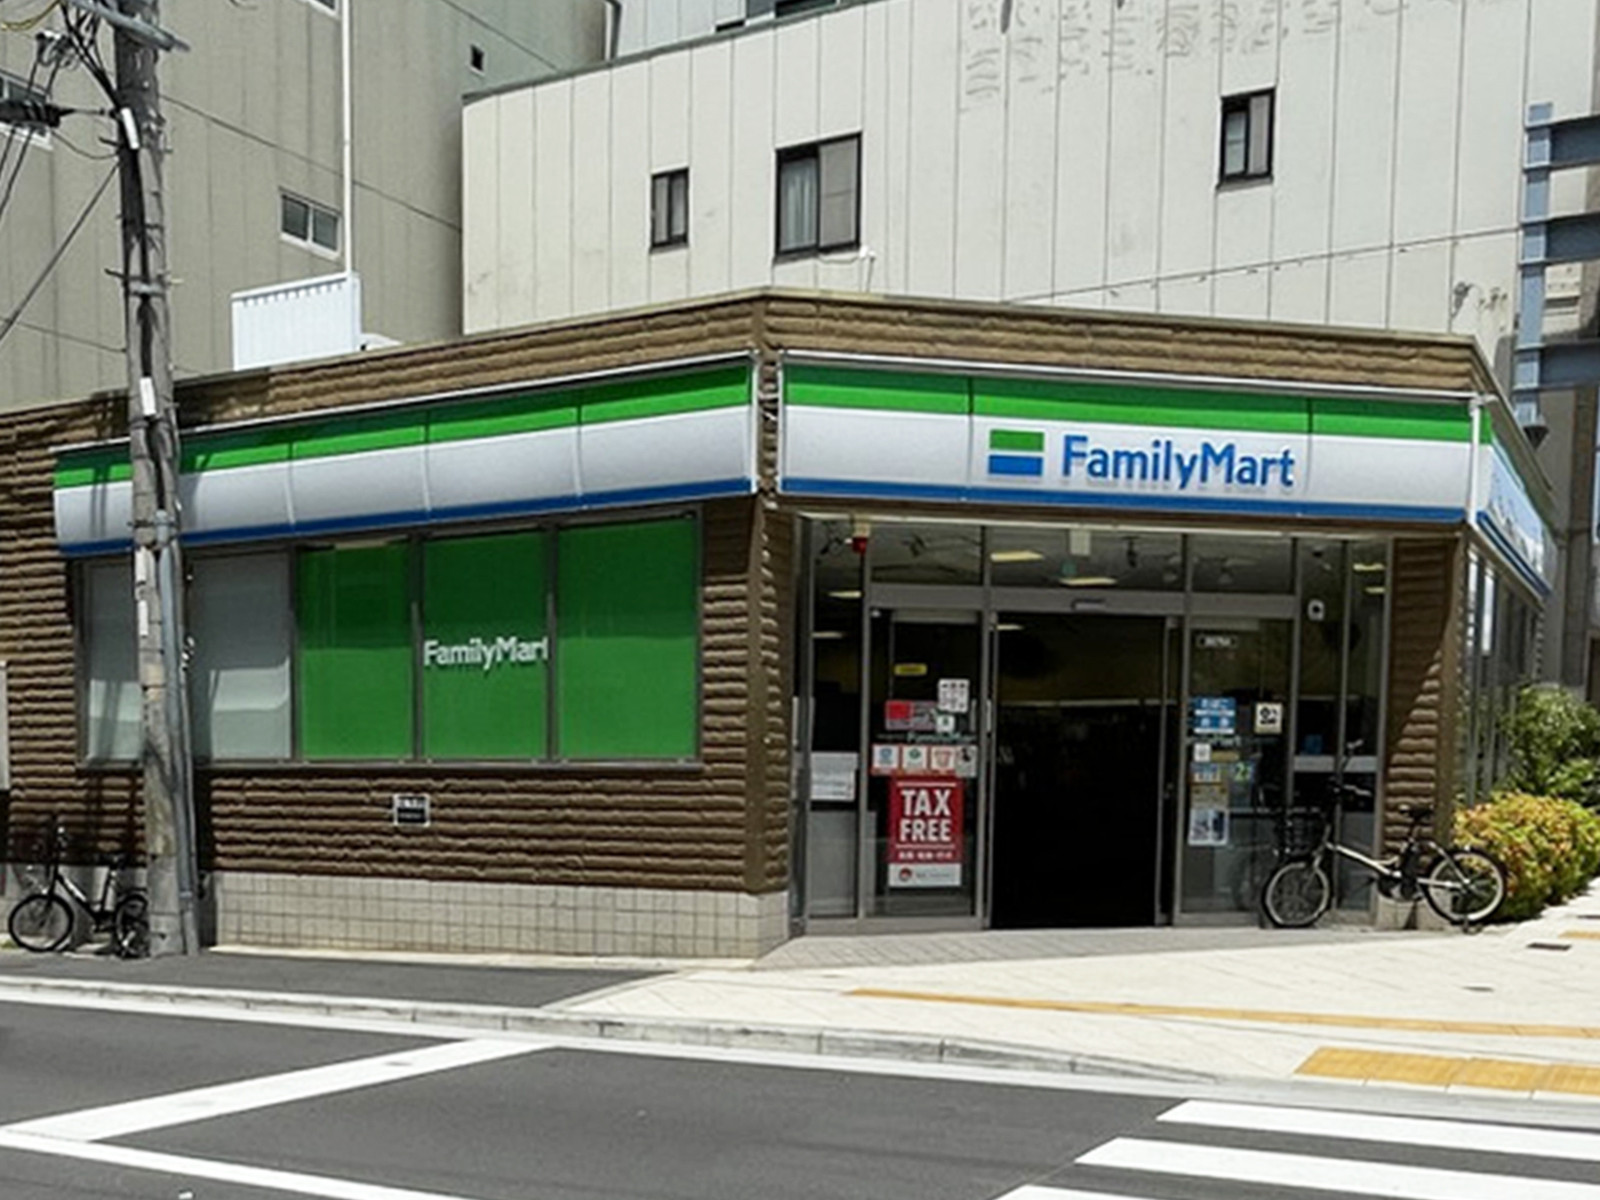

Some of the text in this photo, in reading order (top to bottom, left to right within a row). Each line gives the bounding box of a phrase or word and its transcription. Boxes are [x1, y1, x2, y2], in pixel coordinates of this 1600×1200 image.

[1062, 434, 1295, 490] FamilyMart
[900, 788, 952, 817] TAX
[899, 818, 952, 842] FREE
